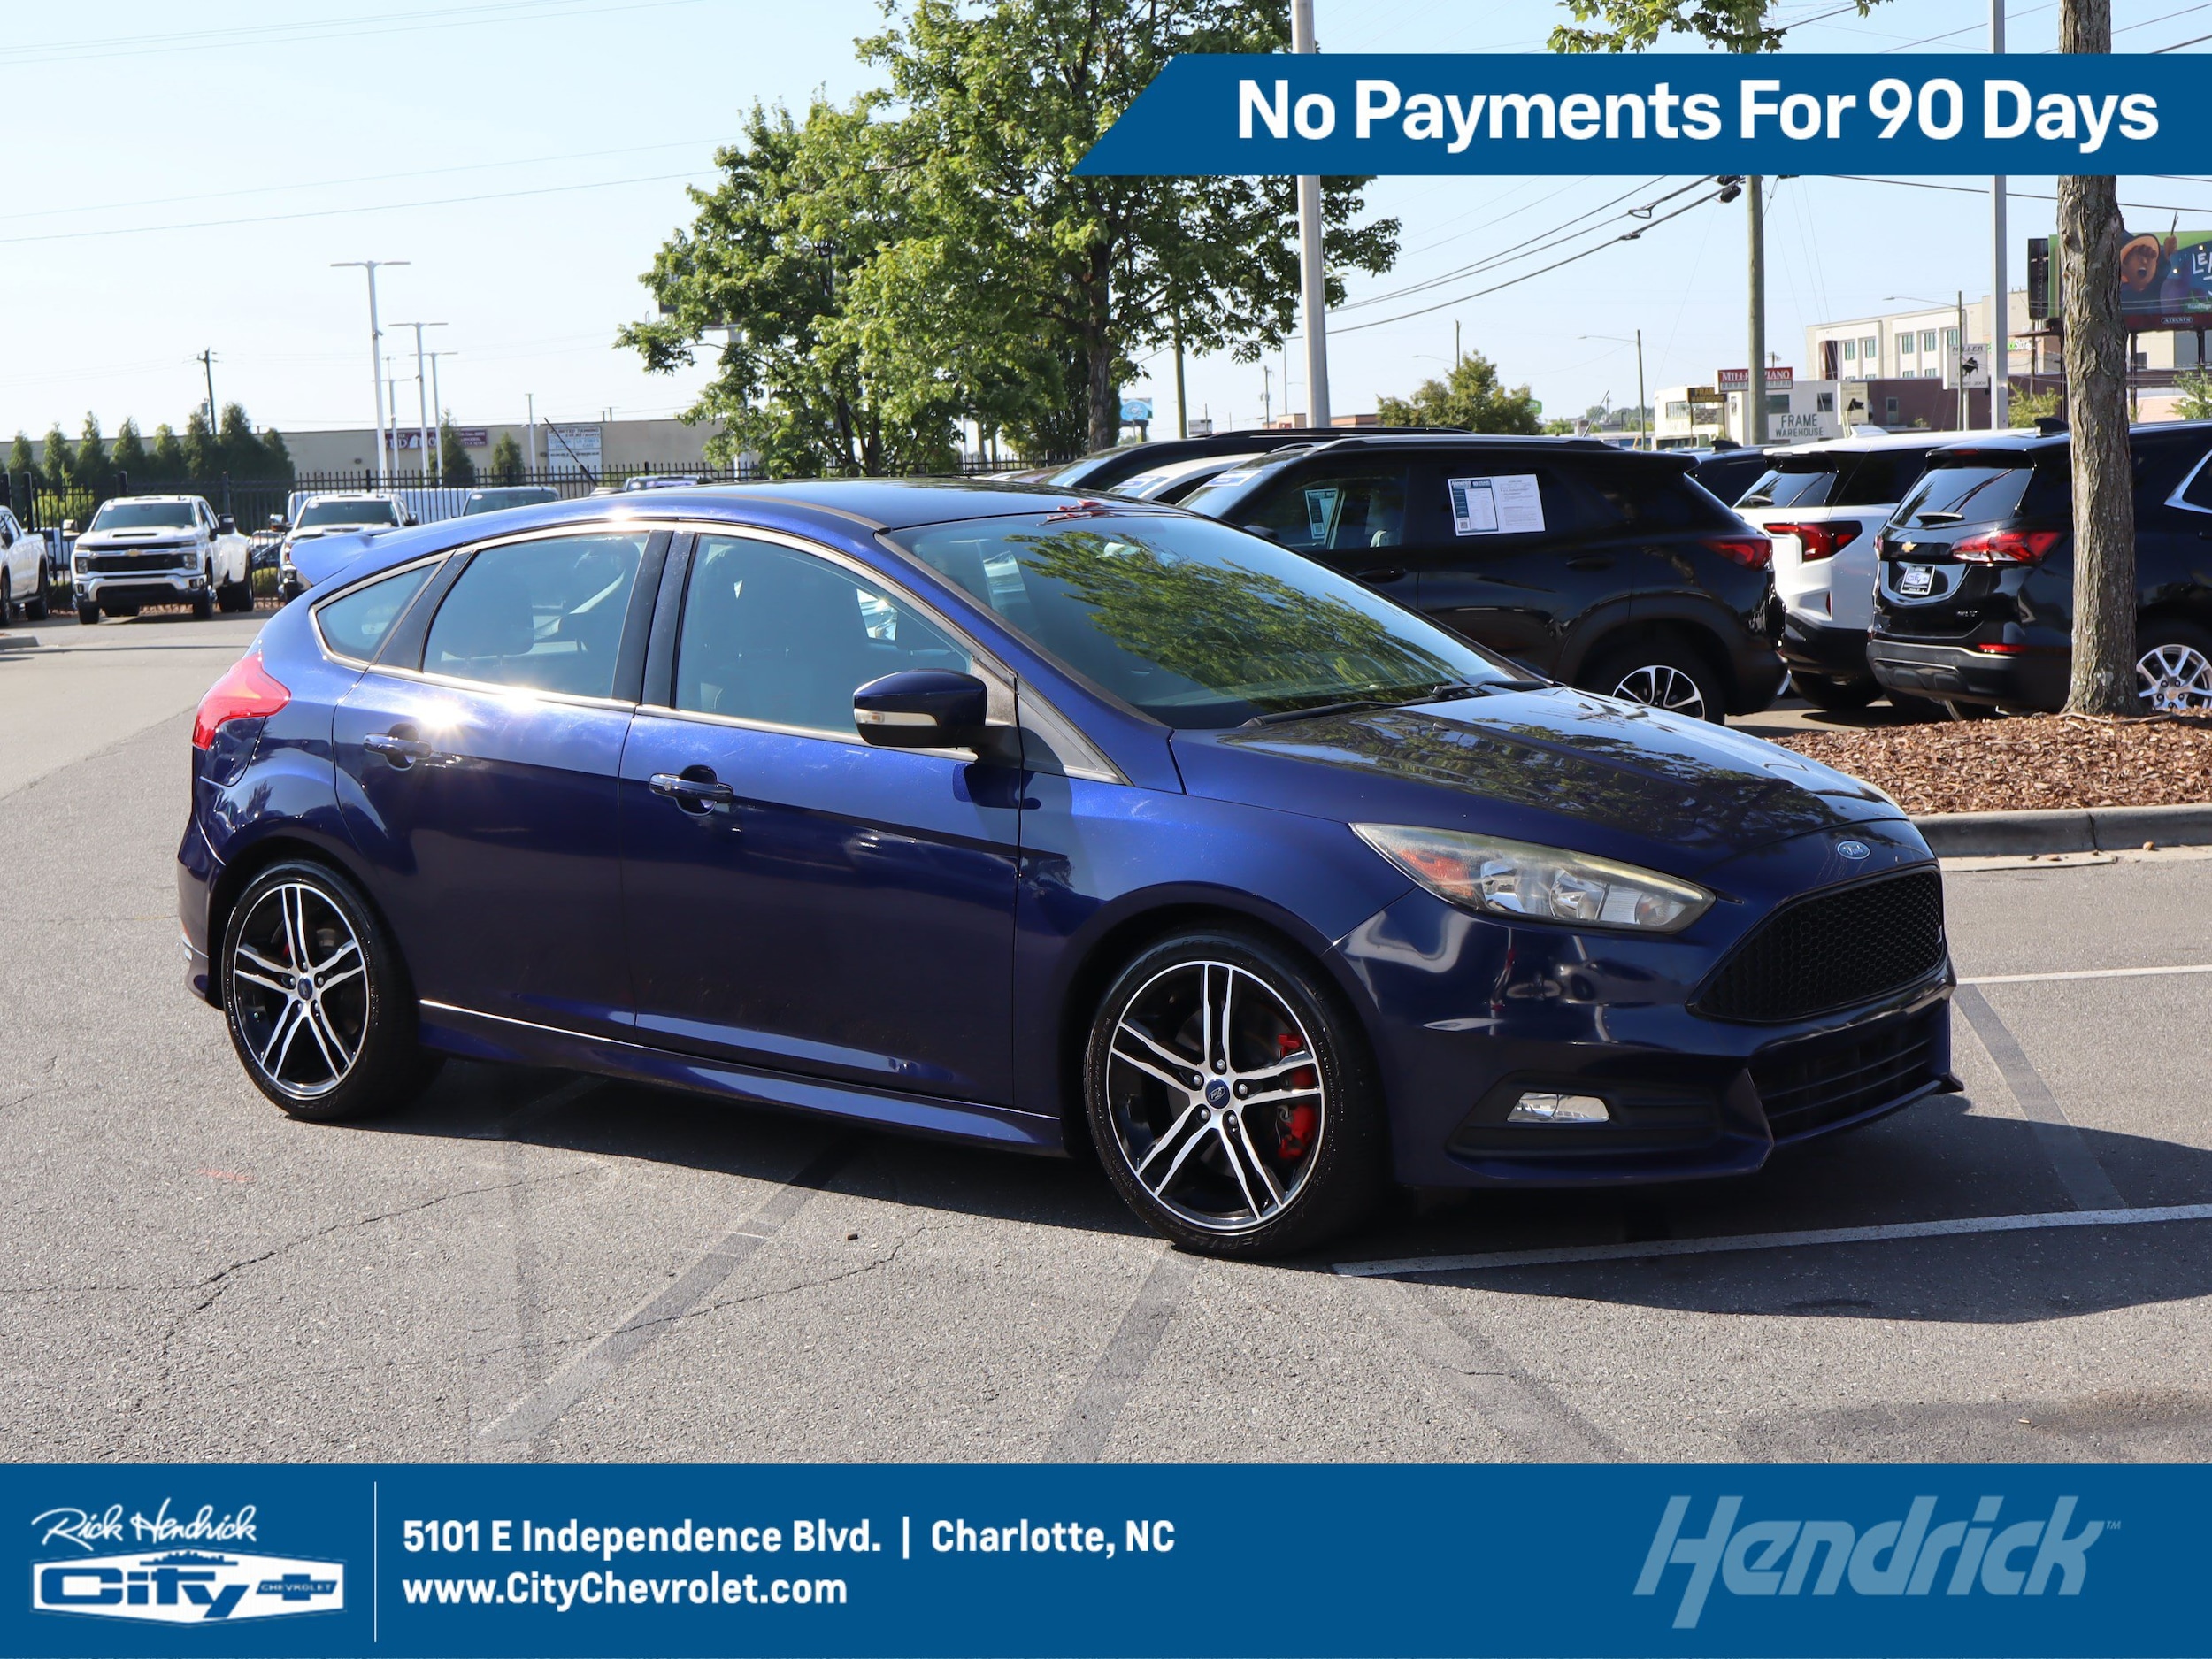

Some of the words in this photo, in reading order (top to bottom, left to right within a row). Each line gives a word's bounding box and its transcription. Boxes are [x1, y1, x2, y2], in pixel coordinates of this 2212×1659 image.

[2192, 251, 2212, 274] LE
[1780, 413, 1818, 428] FRAME
[1775, 426, 1824, 437] WAREHOUSE
